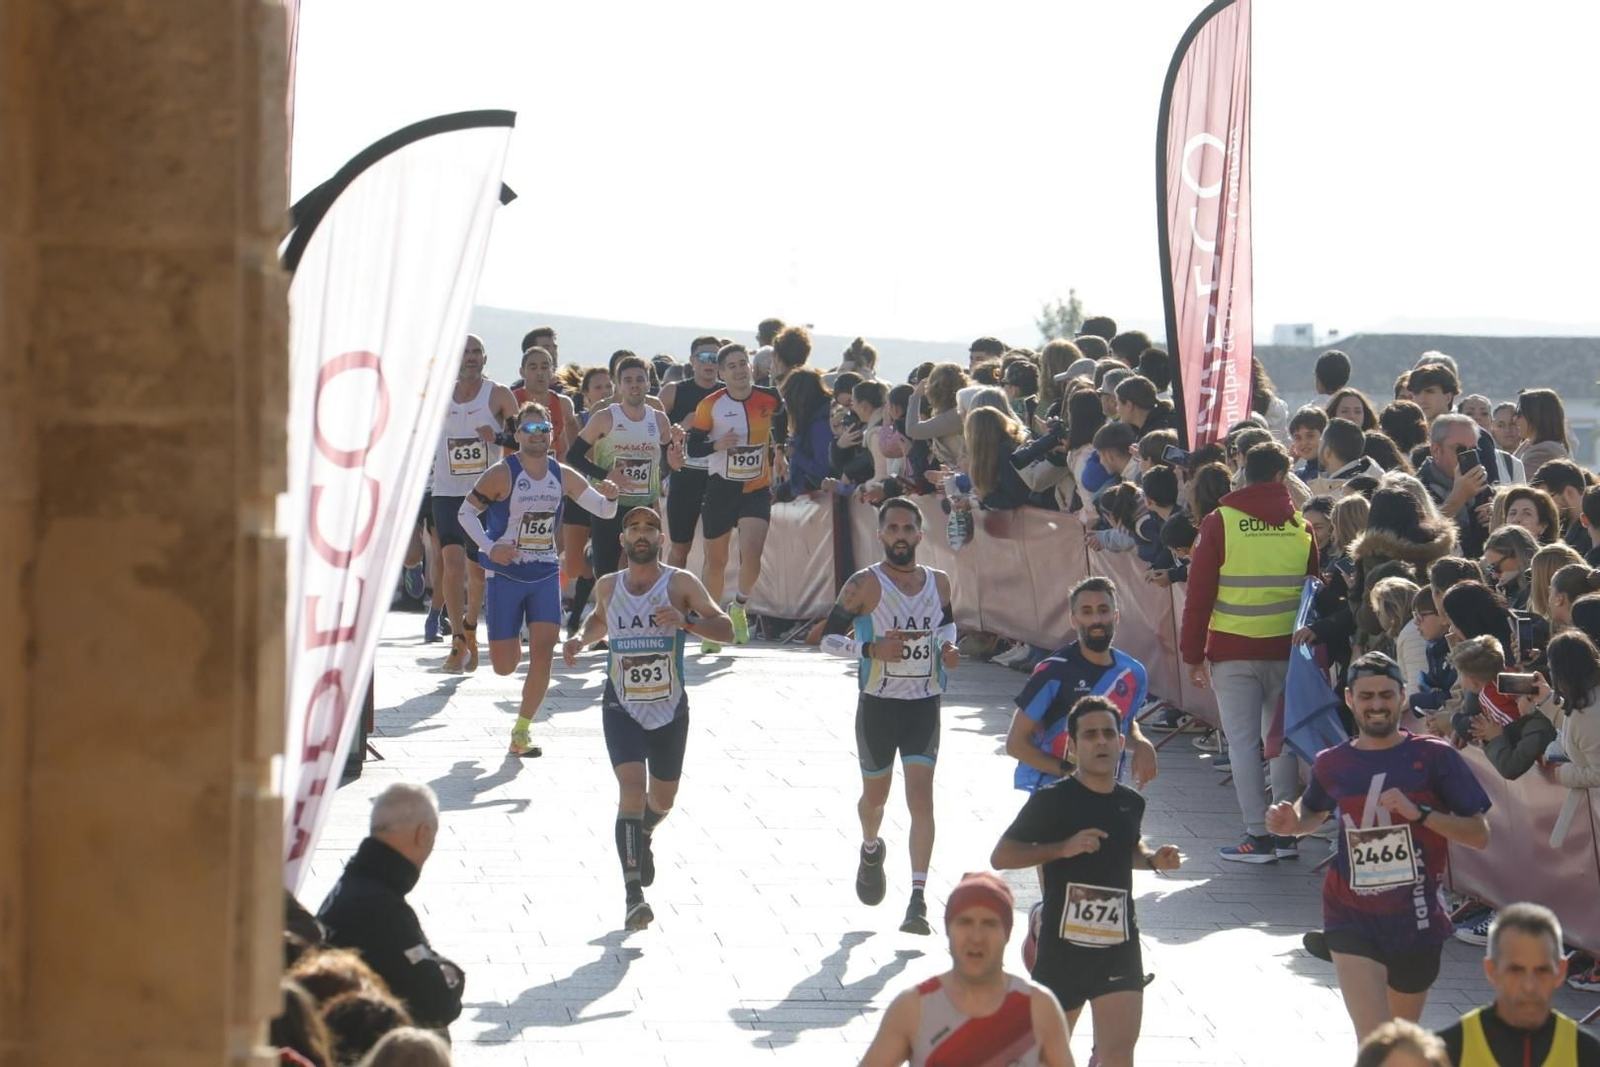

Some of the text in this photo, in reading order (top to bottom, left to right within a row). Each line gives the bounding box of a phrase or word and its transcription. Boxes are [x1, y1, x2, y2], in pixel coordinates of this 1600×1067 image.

[1221, 358, 1242, 428] nicipal
[453, 447, 482, 461] 638
[732, 454, 760, 467] 1901
[617, 614, 659, 630] LAR
[616, 638, 665, 650] RUNNING
[901, 644, 931, 660] 063
[629, 666, 663, 684] 893
[1352, 843, 1409, 866] 2466
[1073, 902, 1120, 926] 1674
